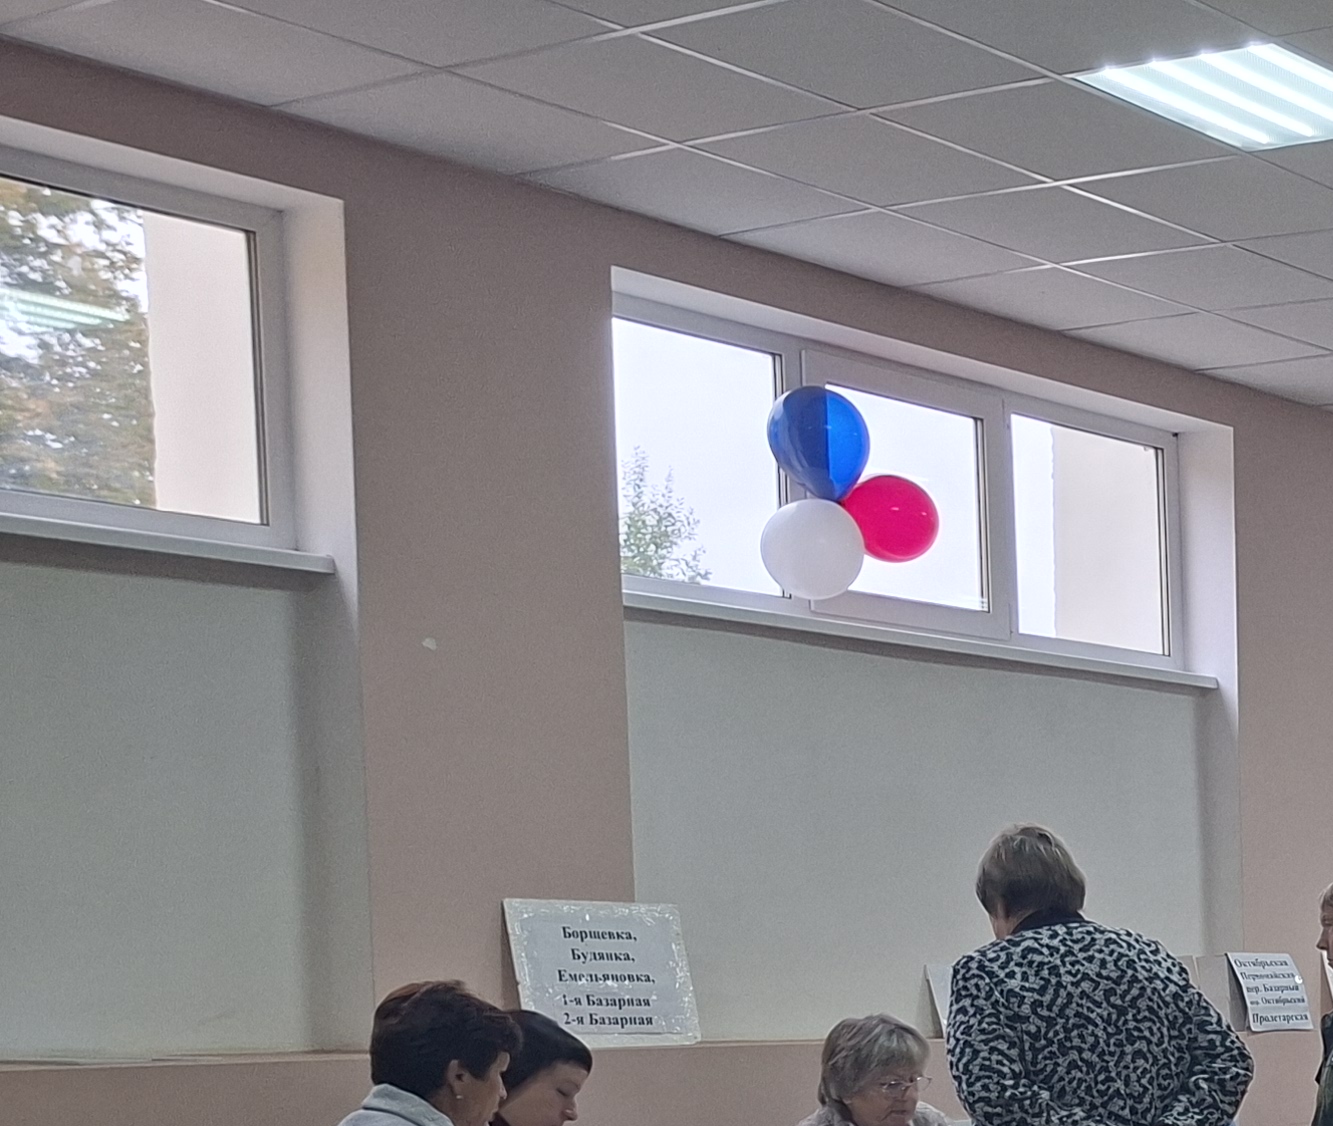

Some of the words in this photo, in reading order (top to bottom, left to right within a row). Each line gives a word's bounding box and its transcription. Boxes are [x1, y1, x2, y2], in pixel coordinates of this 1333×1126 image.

[1234, 958, 1288, 969] Октябрьская
[557, 969, 656, 984] Емельяновка,
[562, 994, 582, 1006] 1-я
[586, 994, 651, 1010] Базарная
[563, 1012, 584, 1025] 2-я
[589, 1012, 653, 1029] Базарная
